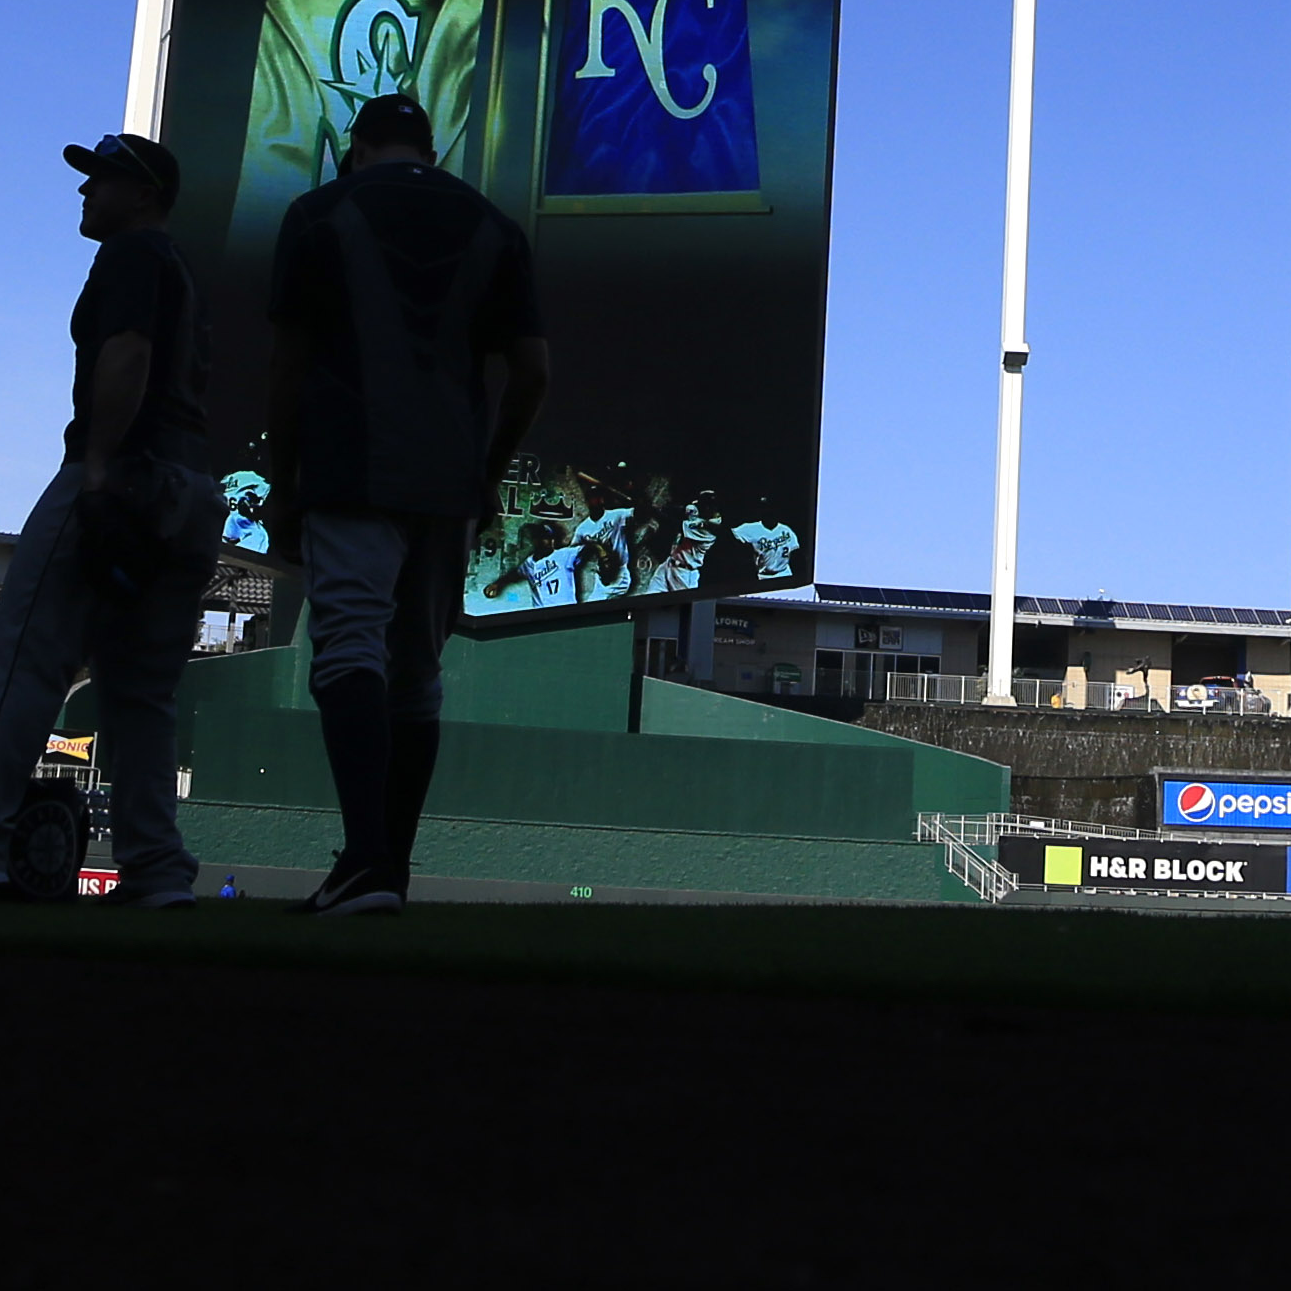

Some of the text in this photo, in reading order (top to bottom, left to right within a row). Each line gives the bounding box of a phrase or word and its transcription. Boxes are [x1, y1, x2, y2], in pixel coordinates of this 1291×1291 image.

[546, 579, 559, 595] 17
[49, 739, 89, 753] SONIC
[1089, 856, 1246, 883] H&R BLOCK
[569, 886, 593, 898] 410
